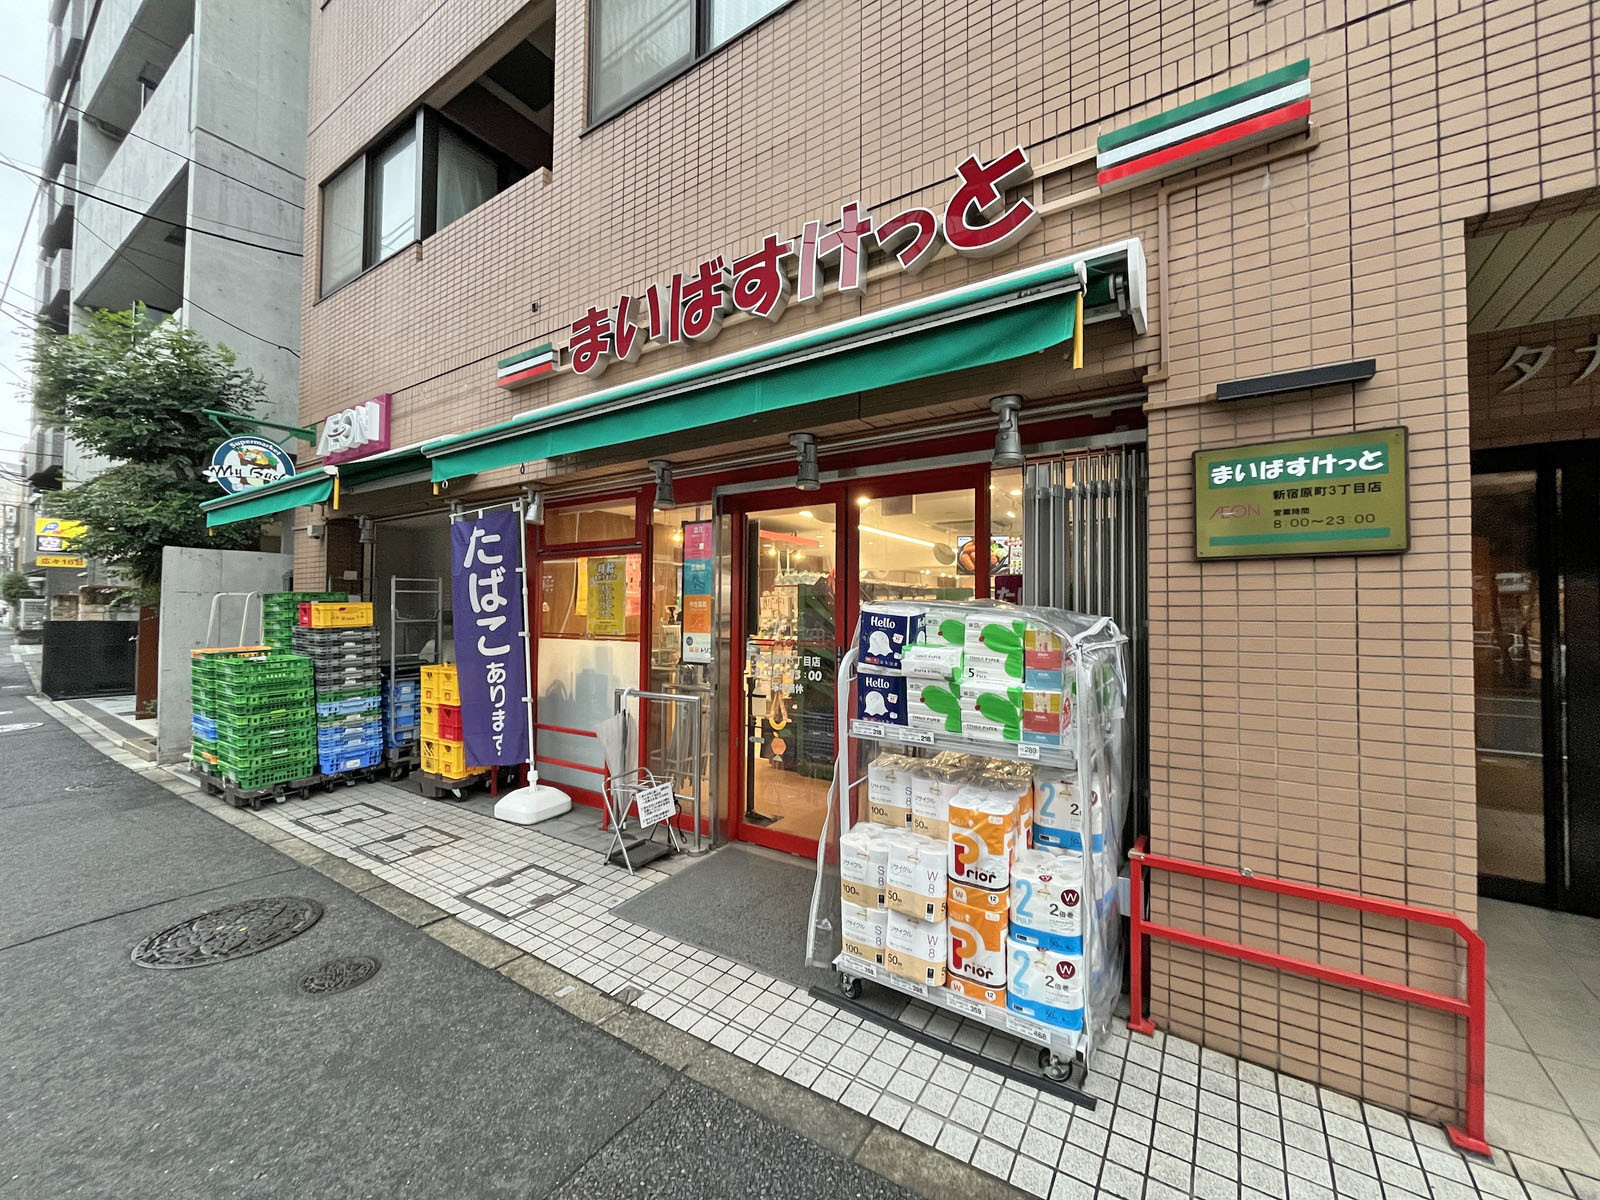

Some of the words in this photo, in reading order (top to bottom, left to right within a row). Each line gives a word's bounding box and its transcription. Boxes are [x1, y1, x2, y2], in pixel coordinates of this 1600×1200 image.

[567, 144, 1037, 377] まいばすけっと
[229, 440, 282, 456] Supermarket
[208, 464, 242, 479] My
[1211, 449, 1384, 485] まいばすけっと
[1273, 481, 1382, 500] 新宿原町3丁目店
[1273, 507, 1310, 516] 営業時間
[870, 615, 896, 629] Hello
[968, 667, 975, 678] 5
[865, 676, 890, 689] Hello
[905, 797, 912, 805] 8
[1039, 782, 1056, 818] 2
[877, 865, 885, 876] S
[926, 870, 939, 882] W
[878, 876, 885, 886] 8
[927, 883, 936, 894] 8
[1015, 878, 1033, 917] 2
[1063, 891, 1078, 902] W
[874, 925, 882, 936] S
[875, 936, 882, 946] 8
[926, 934, 939, 946] W
[928, 948, 936, 959] 8
[1013, 949, 1030, 991] 2
[1058, 963, 1073, 975] W
[1033, 1030, 1047, 1041] 468
